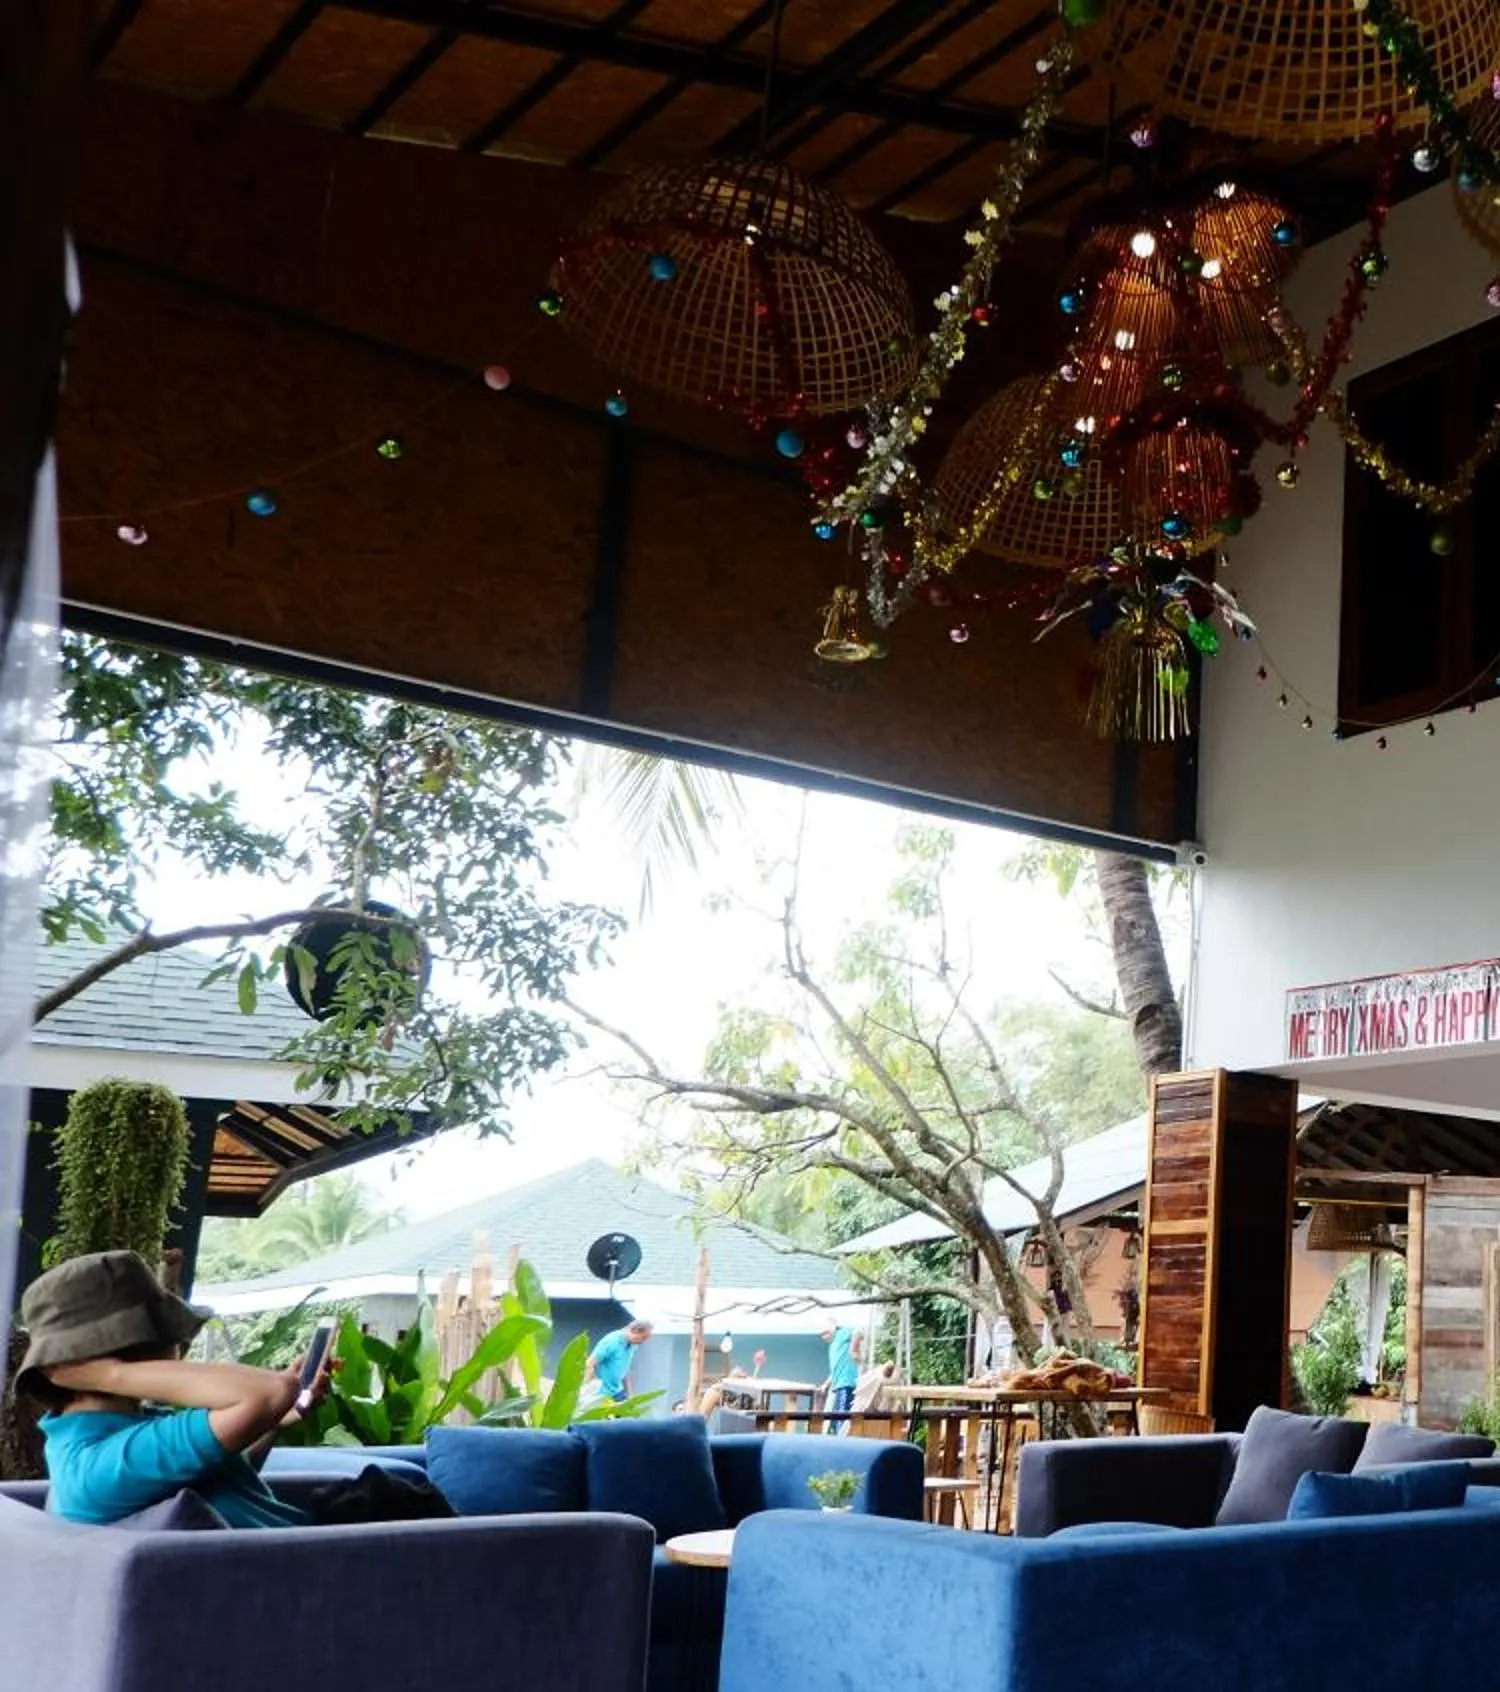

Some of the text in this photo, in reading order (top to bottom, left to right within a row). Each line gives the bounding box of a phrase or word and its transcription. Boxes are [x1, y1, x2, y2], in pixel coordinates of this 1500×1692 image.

[1357, 998, 1409, 1053] XMAS
[1414, 995, 1428, 1045] &
[1433, 984, 1500, 1043] HAPPY
